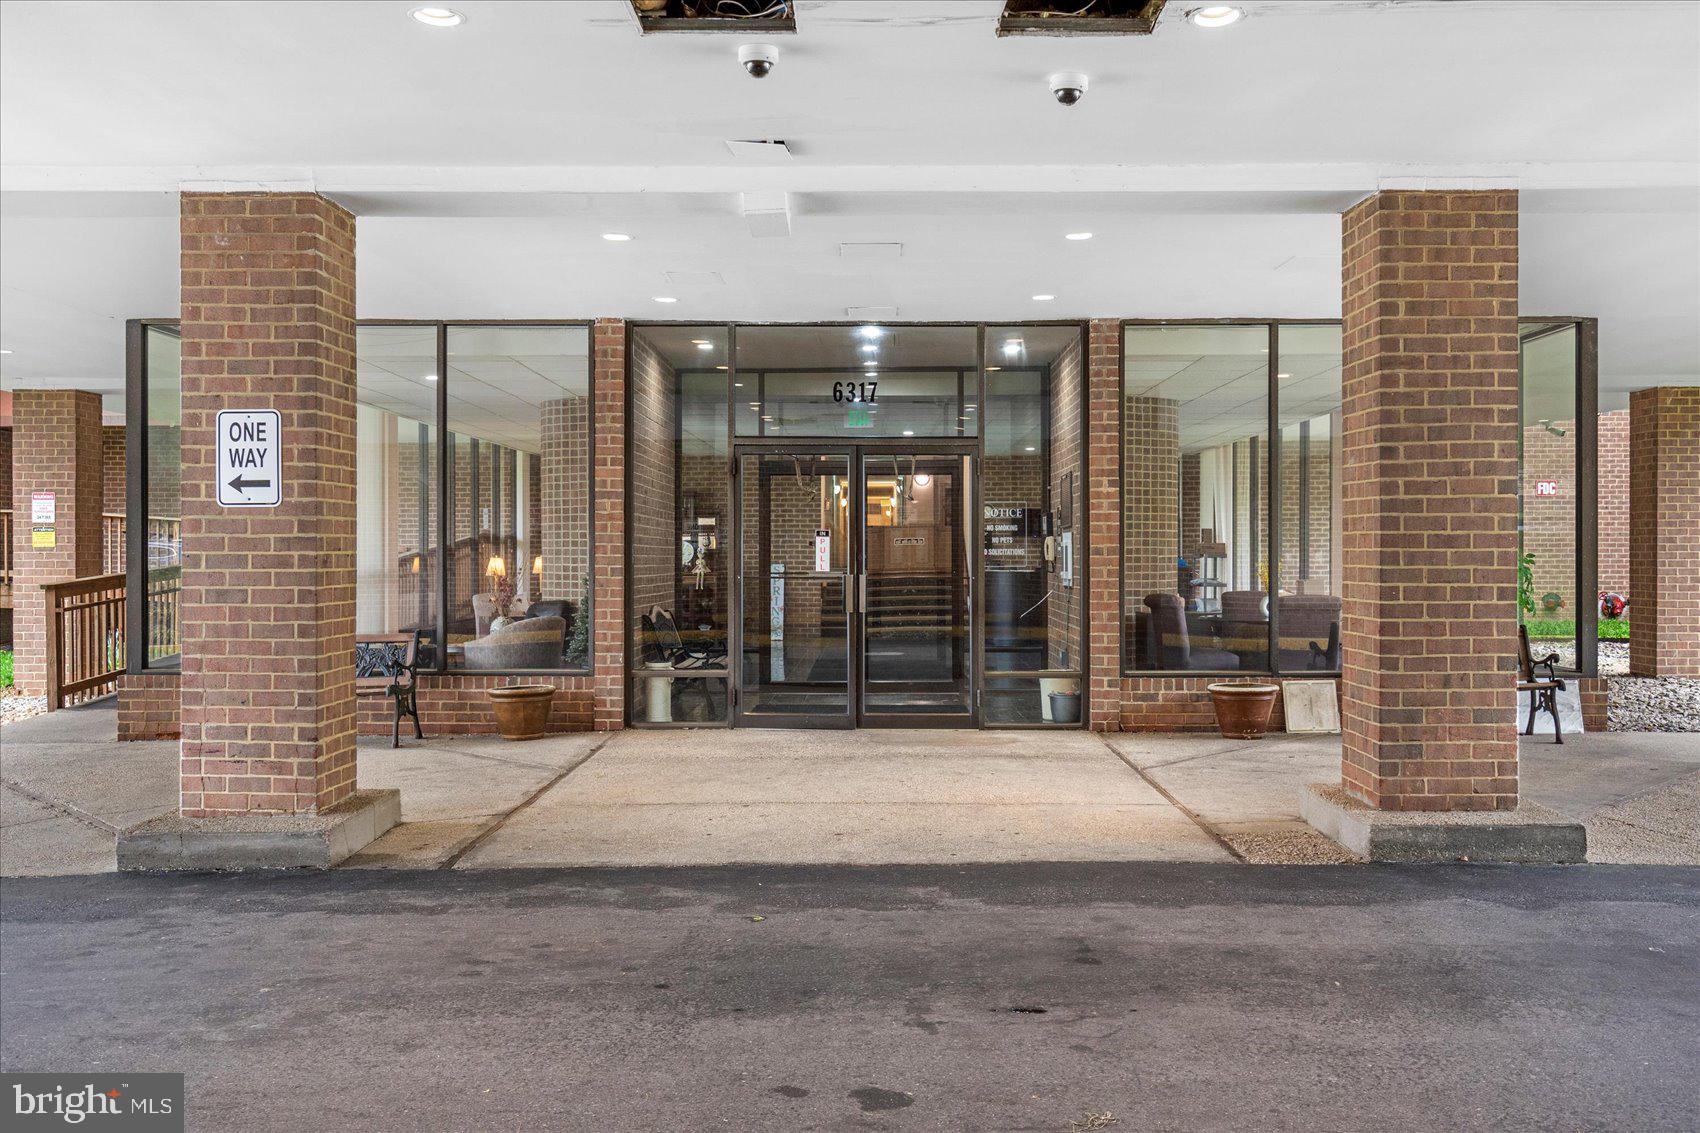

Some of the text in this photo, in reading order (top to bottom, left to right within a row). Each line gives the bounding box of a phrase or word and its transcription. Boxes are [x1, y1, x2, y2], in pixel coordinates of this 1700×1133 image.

[833, 381, 877, 402] 6317
[229, 422, 267, 442] ONE
[229, 448, 267, 468] WAY
[1537, 482, 1556, 495] FDC
